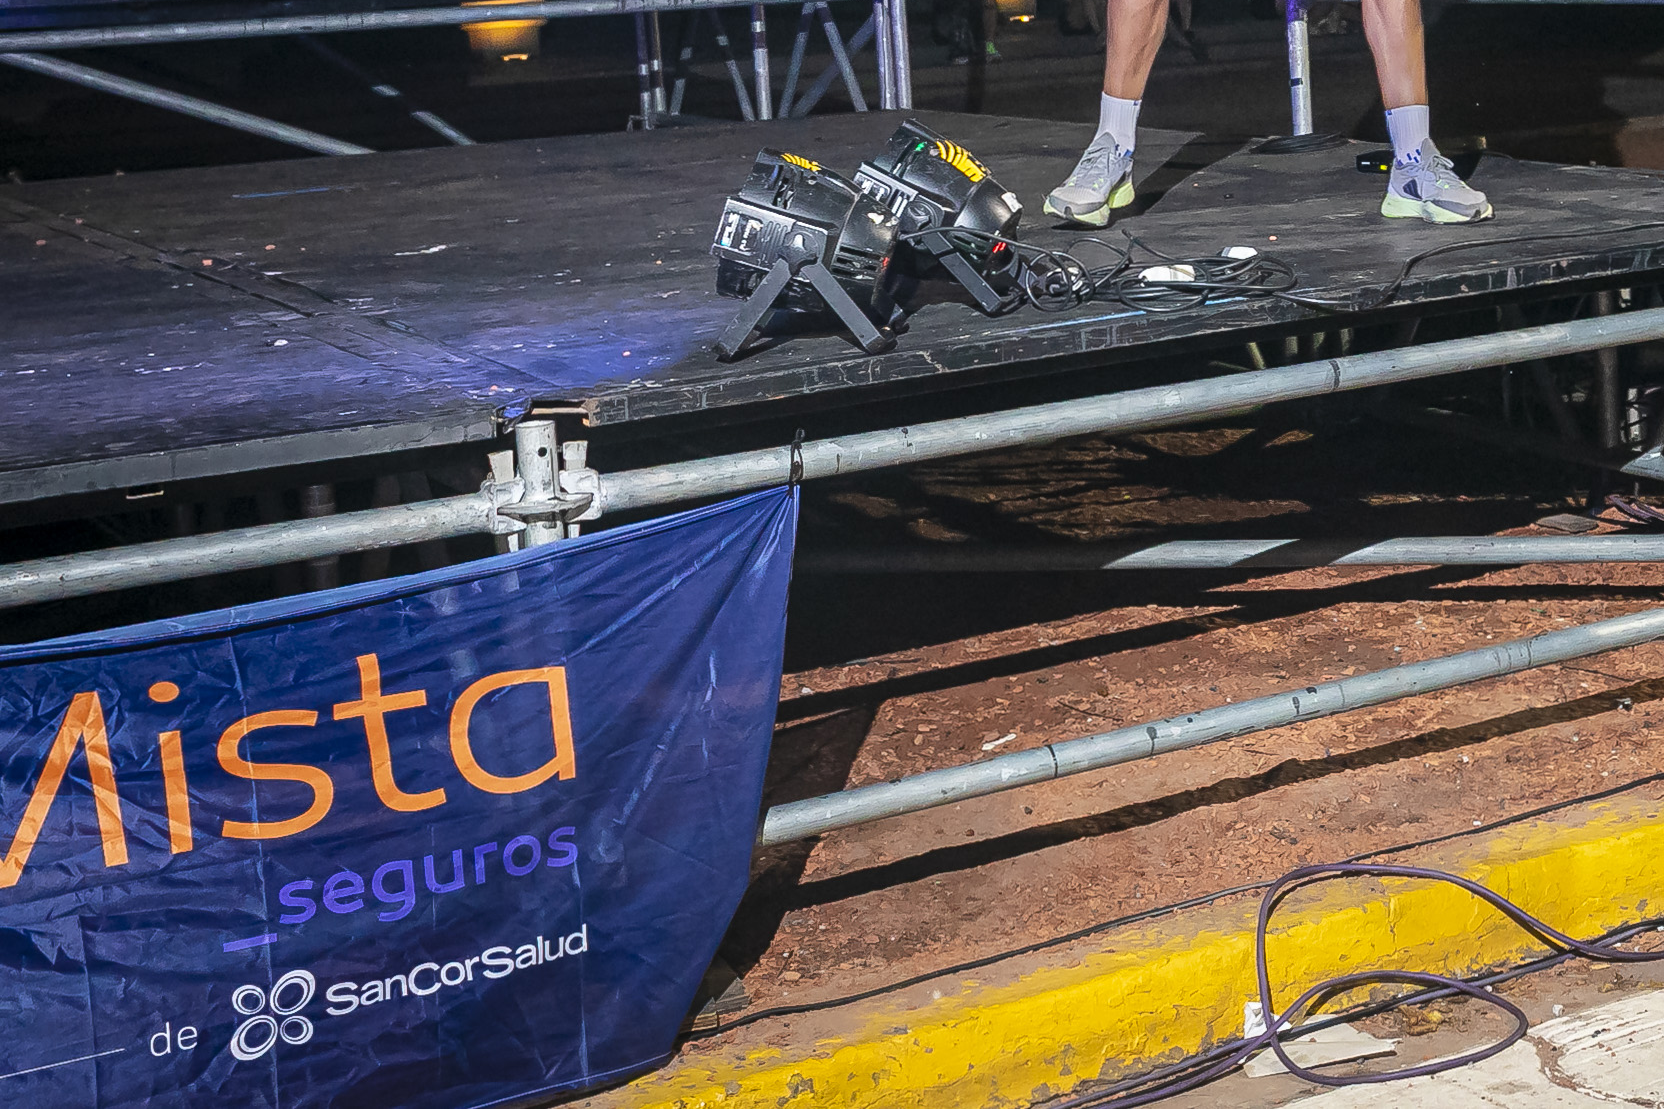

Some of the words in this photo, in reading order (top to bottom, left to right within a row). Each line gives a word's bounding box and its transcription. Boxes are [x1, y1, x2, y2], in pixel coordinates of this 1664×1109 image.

[278, 826, 578, 925] seguros
[150, 1022, 198, 1057] de
[325, 923, 588, 1016] SanCorSalud
